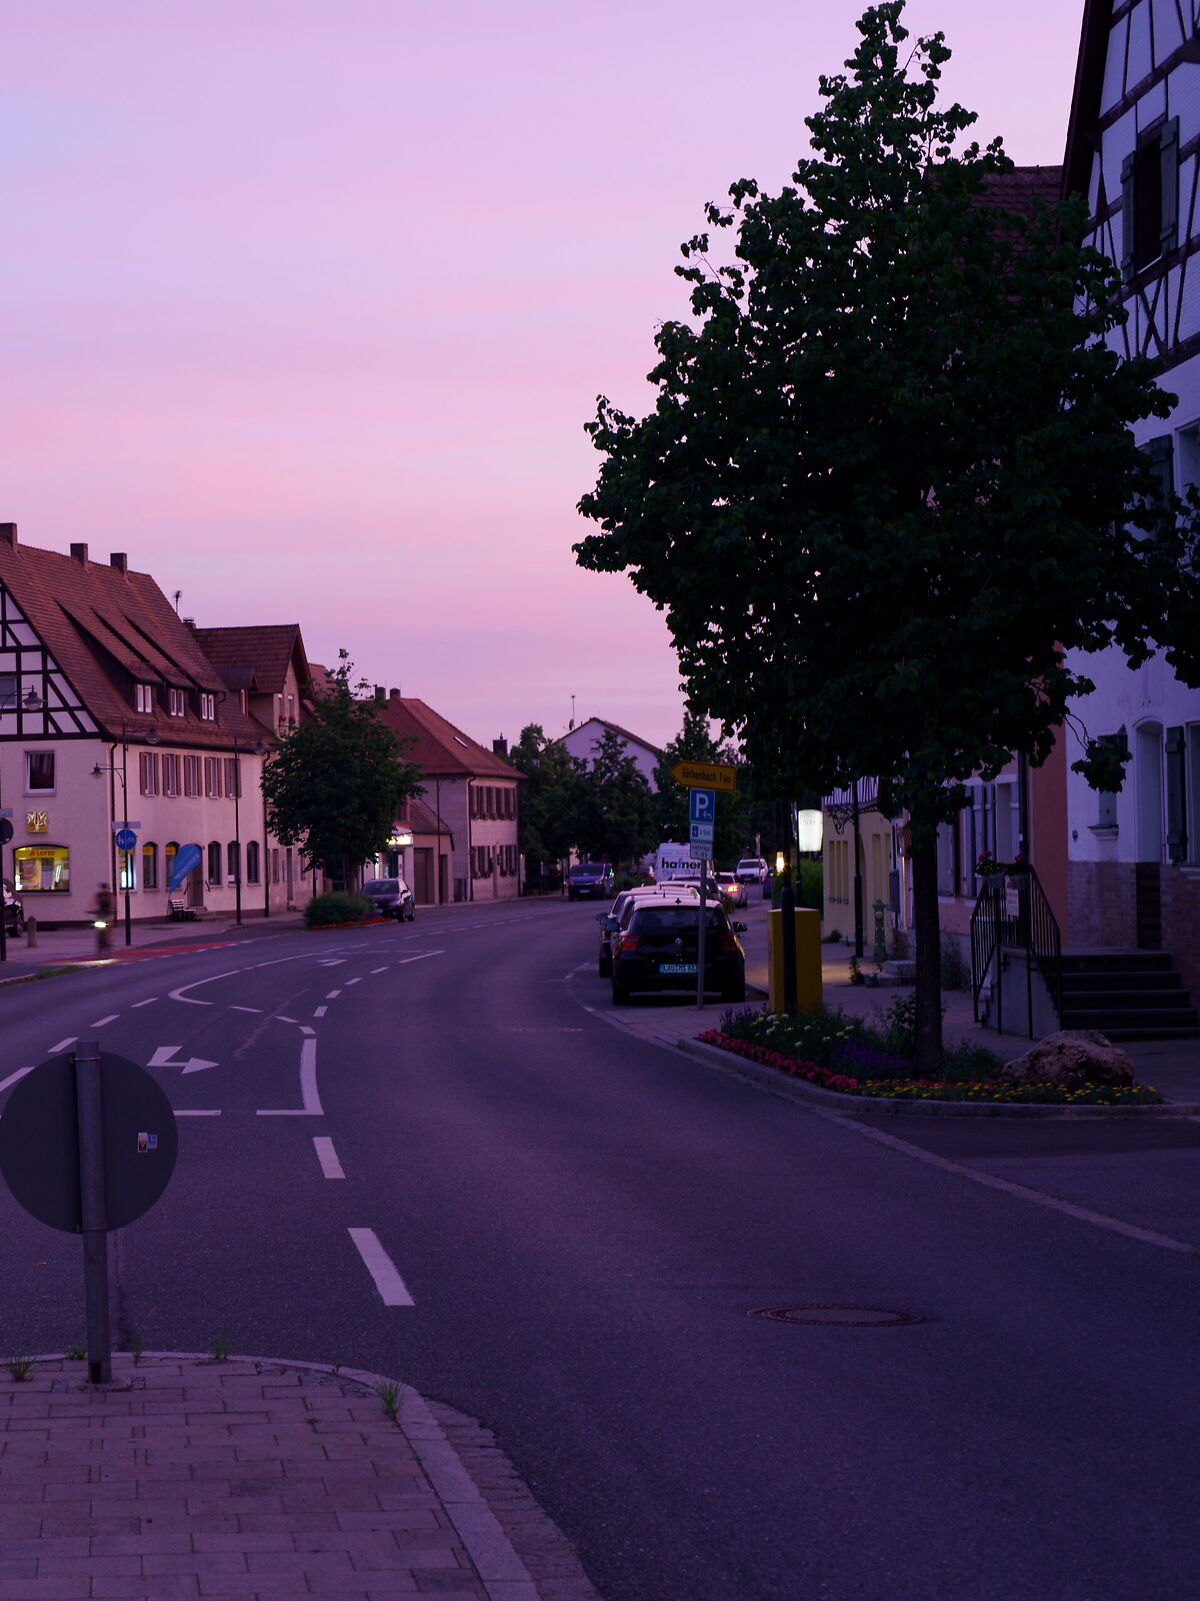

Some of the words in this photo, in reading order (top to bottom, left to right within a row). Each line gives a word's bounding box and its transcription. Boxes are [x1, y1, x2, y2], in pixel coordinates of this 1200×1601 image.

[682, 767, 717, 781] Röthenbach
[695, 793, 709, 818] P
[662, 857, 701, 869] hafner
